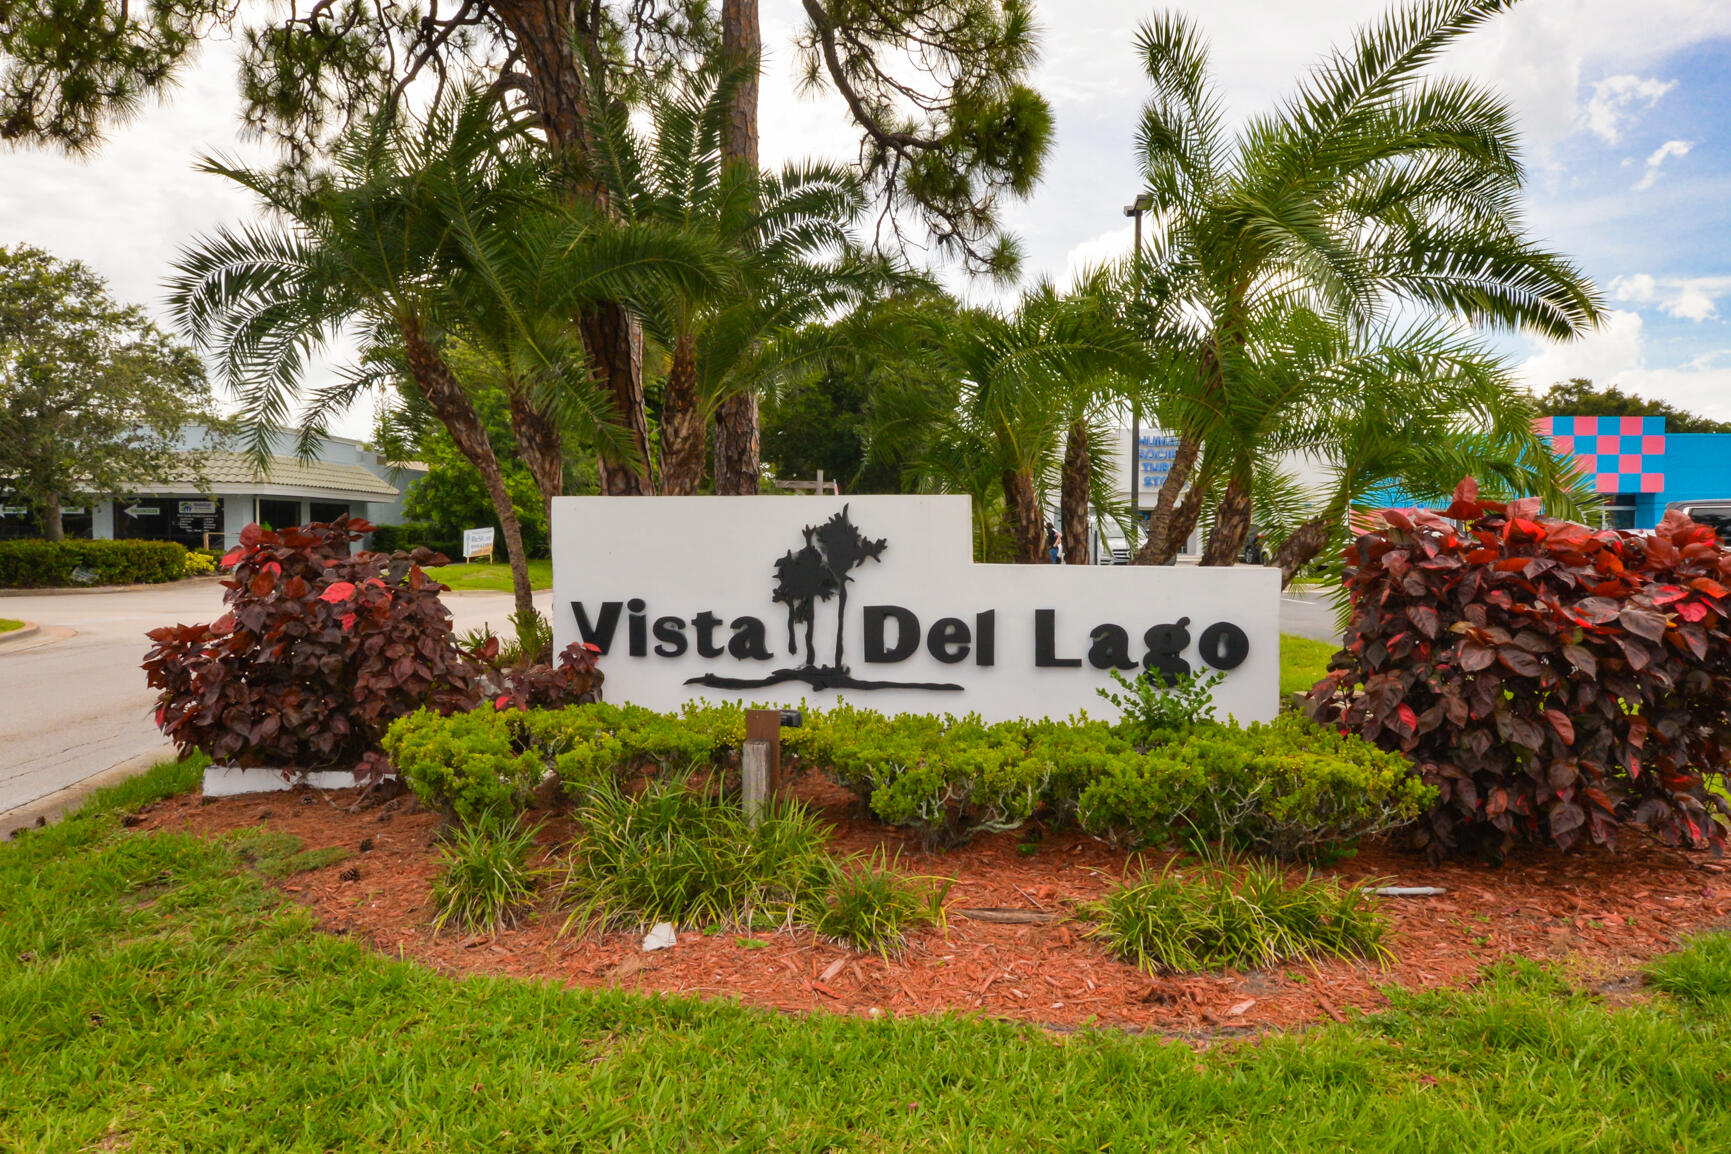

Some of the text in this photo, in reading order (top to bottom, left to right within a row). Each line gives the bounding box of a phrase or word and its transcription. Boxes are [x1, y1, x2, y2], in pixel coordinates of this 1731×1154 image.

[1139, 436, 1181, 447] HUMA
[570, 597, 1251, 688] Vista Del Lago
